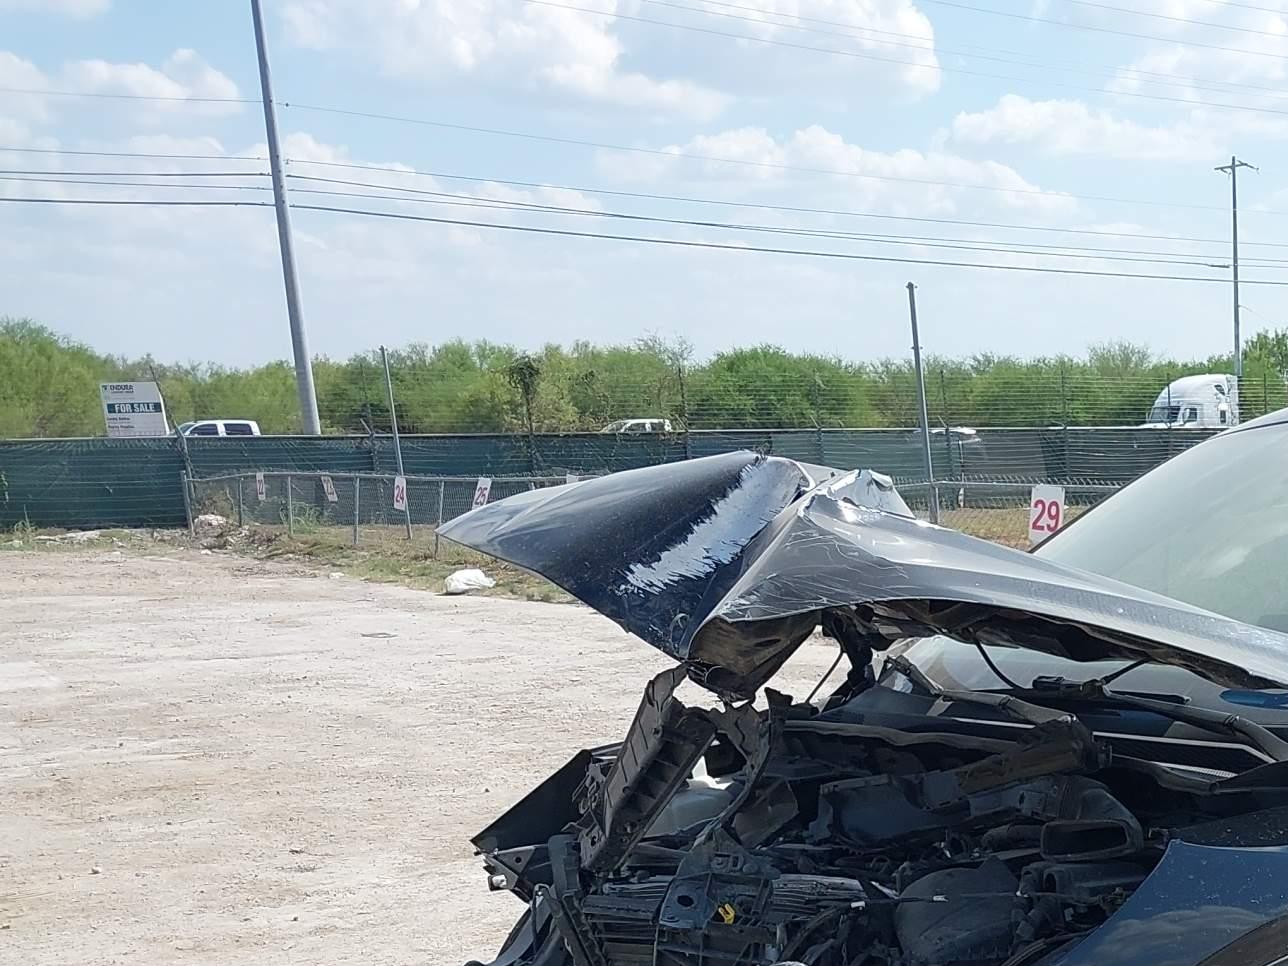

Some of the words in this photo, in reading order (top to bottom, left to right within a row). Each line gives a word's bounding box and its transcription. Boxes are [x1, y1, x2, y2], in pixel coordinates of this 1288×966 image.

[114, 403, 132, 413] FOR
[133, 403, 155, 412] SALE
[395, 484, 405, 504] 24
[474, 487, 488, 505] 25
[1031, 499, 1060, 533] 29
